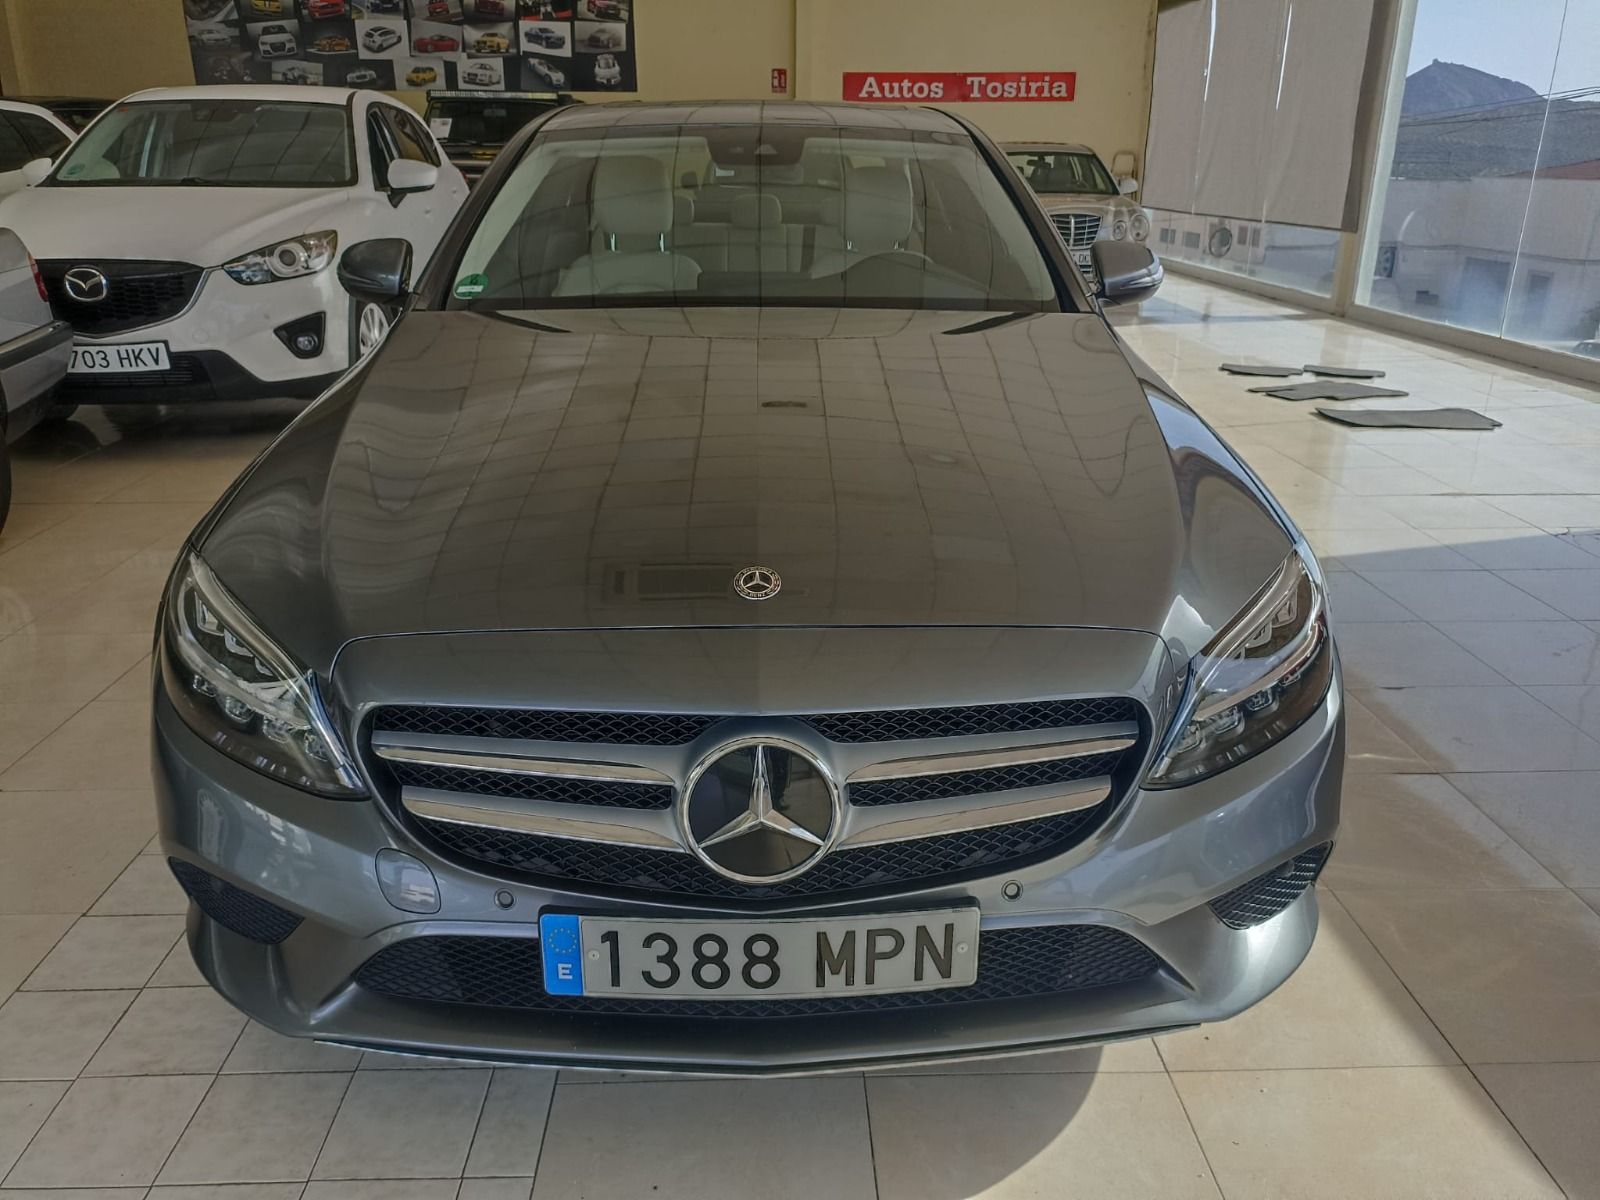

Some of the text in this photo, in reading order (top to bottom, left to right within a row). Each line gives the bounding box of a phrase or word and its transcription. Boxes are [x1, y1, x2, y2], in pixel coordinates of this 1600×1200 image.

[859, 76, 1067, 98] Autos Tosiria
[117, 347, 160, 367] HKV
[557, 923, 954, 989] E 1388 MPN
